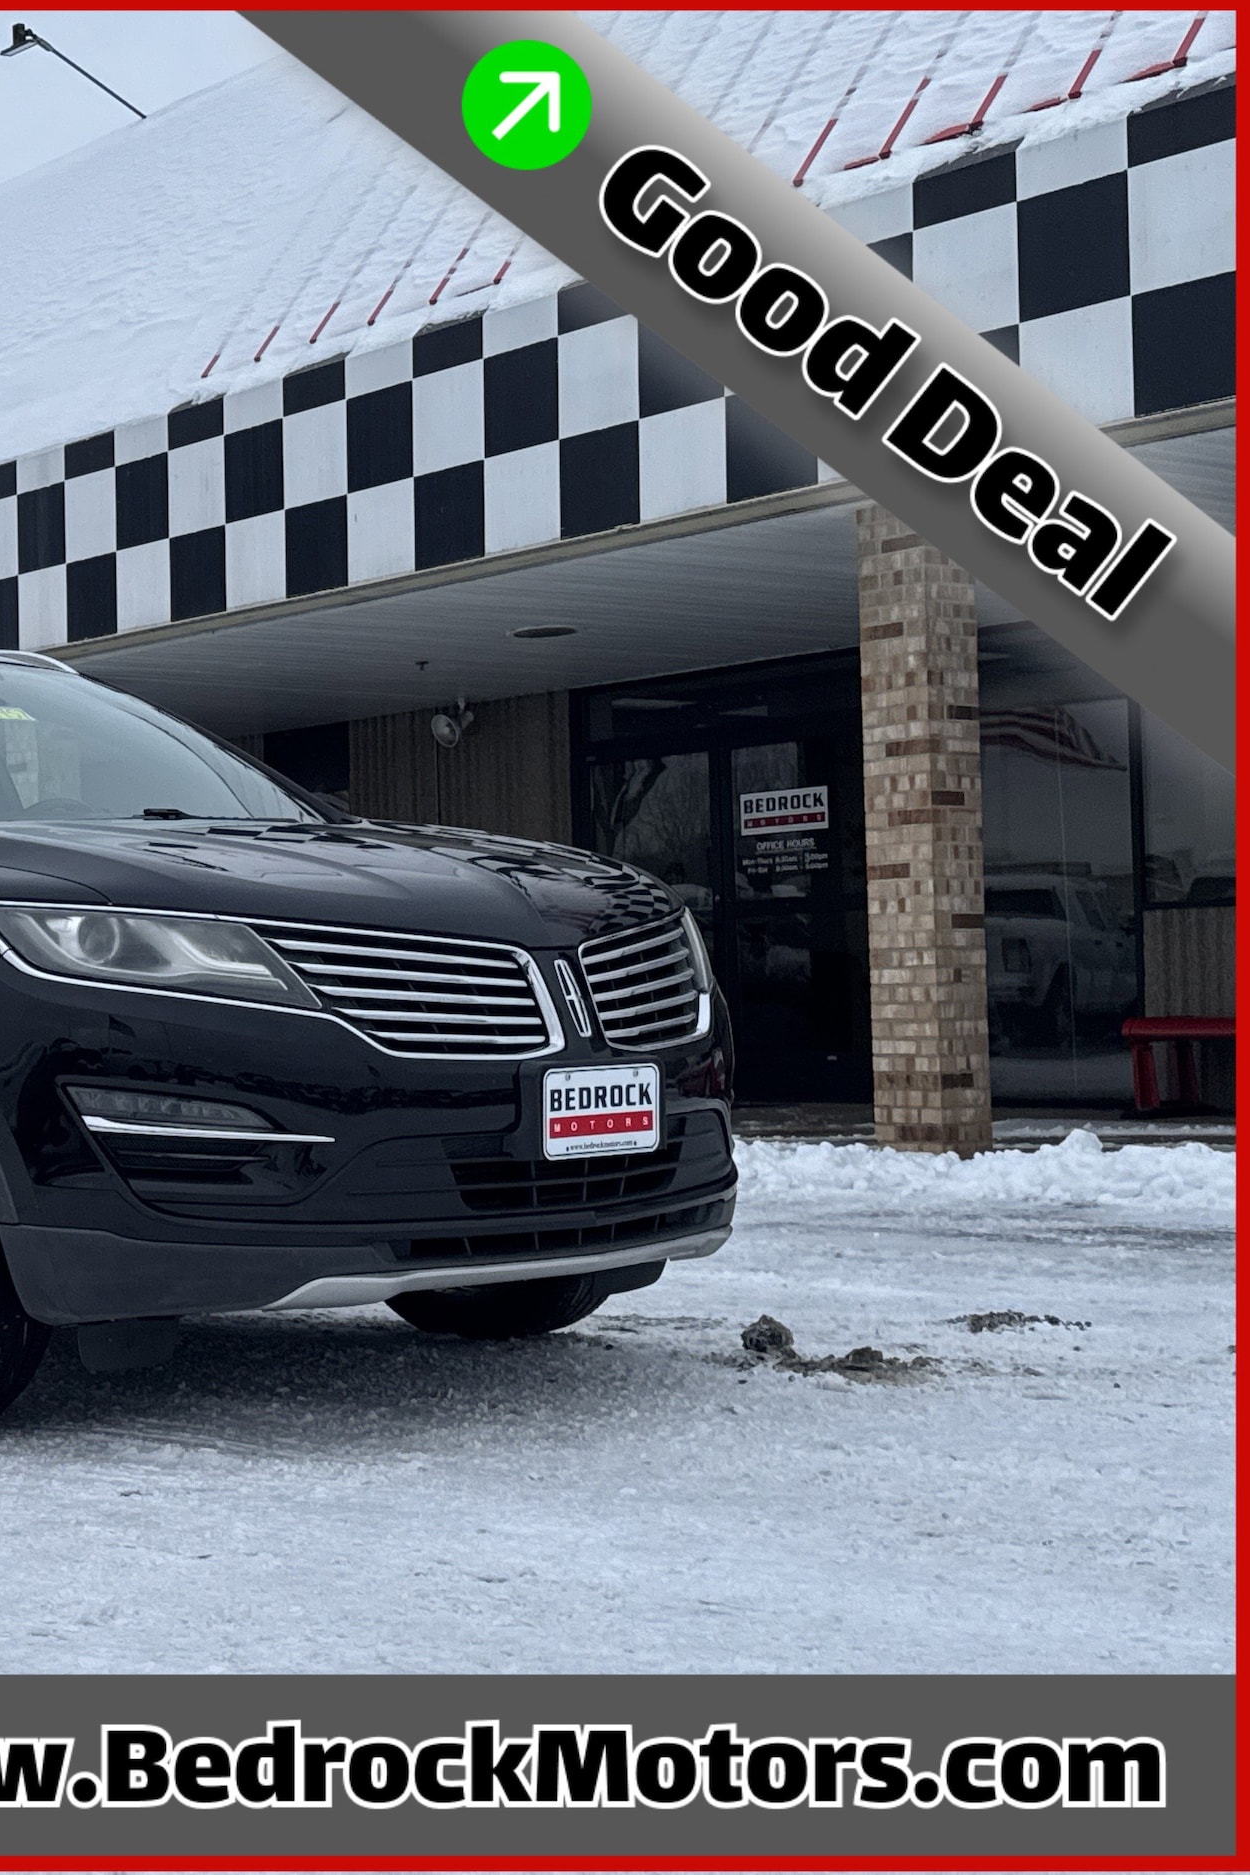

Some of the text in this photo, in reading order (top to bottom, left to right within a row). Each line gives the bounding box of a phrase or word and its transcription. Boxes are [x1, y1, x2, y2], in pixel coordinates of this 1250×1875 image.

[744, 792, 825, 814] BEDROCK
[747, 814, 822, 828] MOTORS
[756, 837, 815, 851] OFFICE HOURS
[550, 1083, 653, 1112] BEDROCK
[554, 1117, 649, 1133] MOTORS
